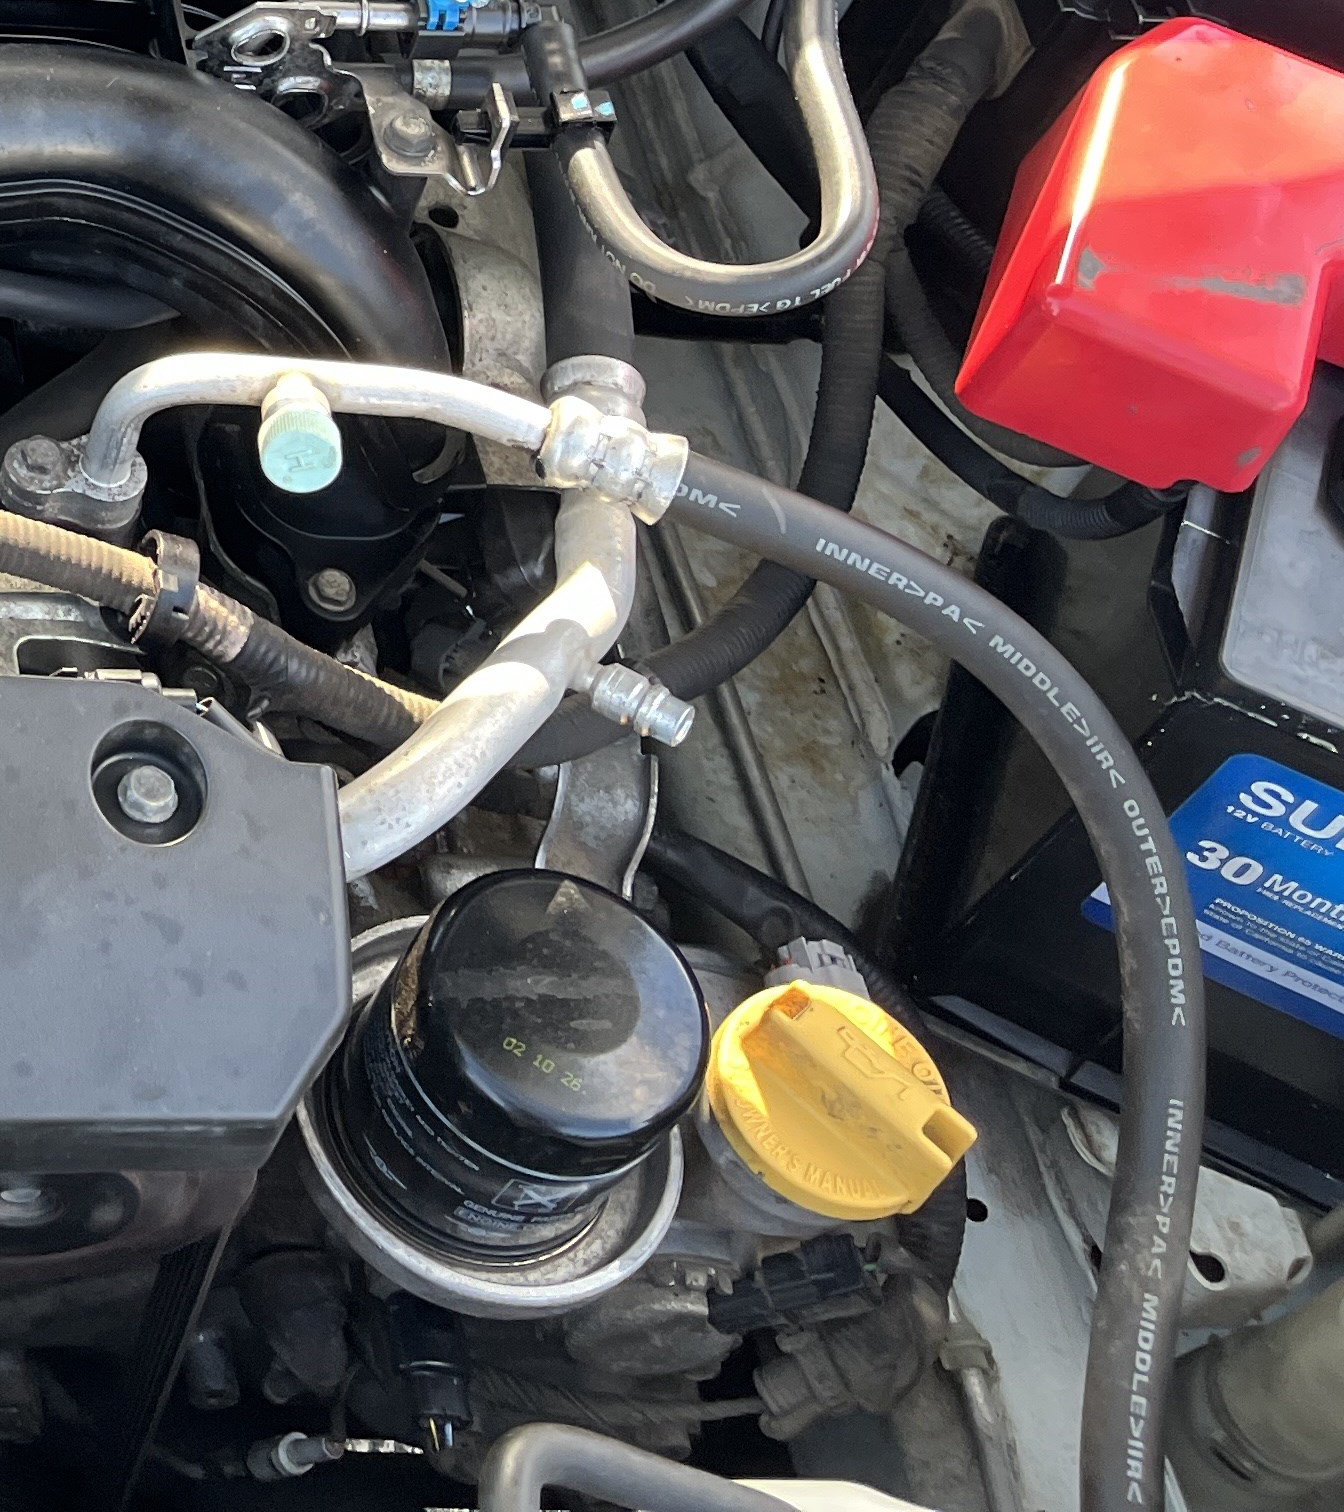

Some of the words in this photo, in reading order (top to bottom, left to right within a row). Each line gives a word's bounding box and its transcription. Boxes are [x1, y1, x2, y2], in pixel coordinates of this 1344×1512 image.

[1226, 804, 1259, 824] 12V
[1261, 821, 1335, 856] BATTERY
[1238, 780, 1344, 851] SU
[1185, 839, 1264, 886] 30
[1263, 873, 1344, 922] Mont
[501, 1036, 527, 1058] 02
[532, 1053, 556, 1075] 10
